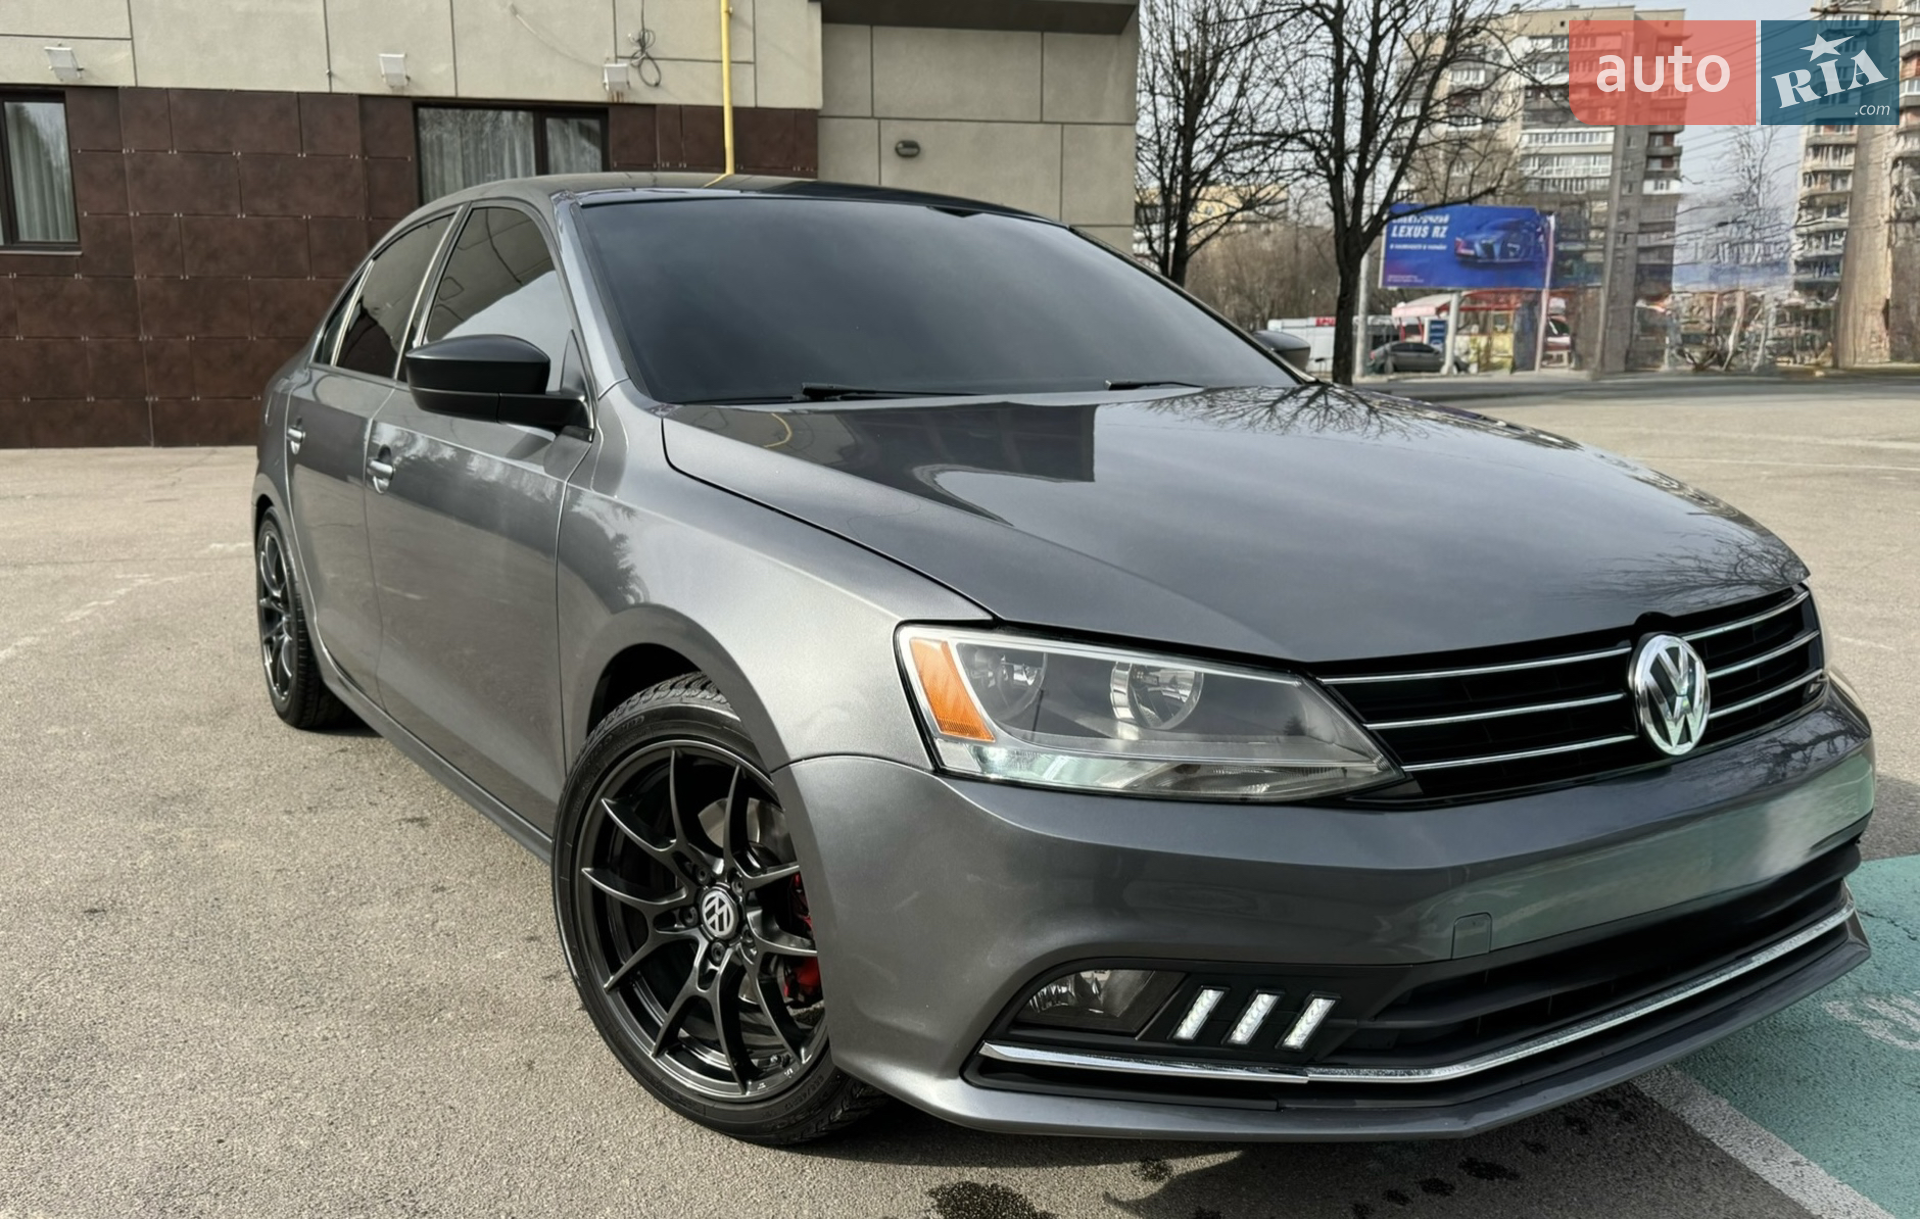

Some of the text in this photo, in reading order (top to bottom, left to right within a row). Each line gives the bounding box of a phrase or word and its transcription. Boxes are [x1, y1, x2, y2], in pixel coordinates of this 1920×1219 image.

[1391, 225, 1449, 239] LEXUS RZ
[1635, 634, 1710, 755] VW
